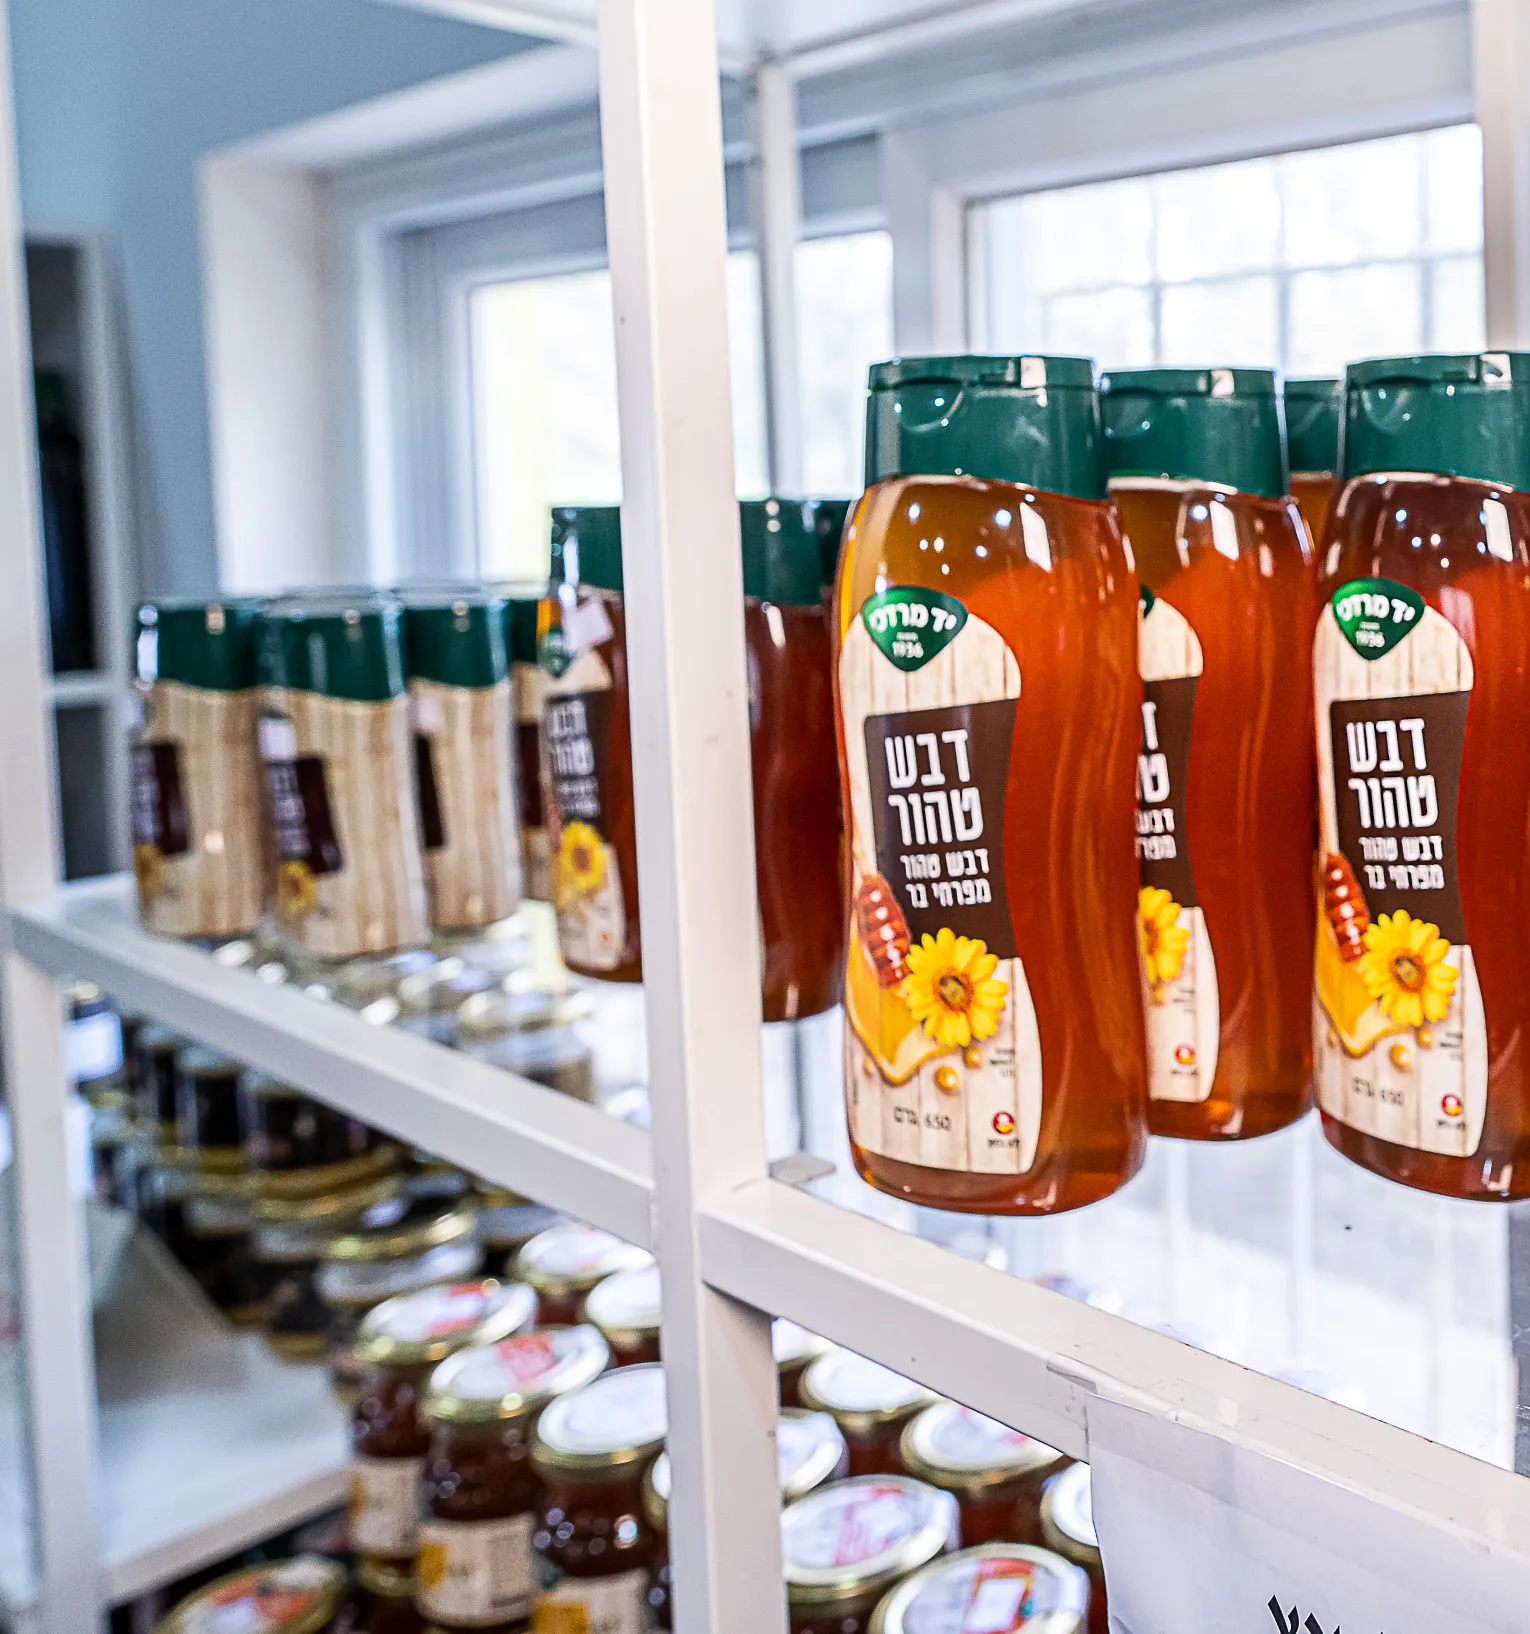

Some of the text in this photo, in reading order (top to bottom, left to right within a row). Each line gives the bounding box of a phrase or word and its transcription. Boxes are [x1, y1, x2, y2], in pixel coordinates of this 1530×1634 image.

[885, 729, 970, 789] דבש
[1346, 718, 1427, 773] דבש
[888, 786, 983, 846] טהור
[1348, 774, 1439, 829] טהור
[945, 848, 990, 877] דבש
